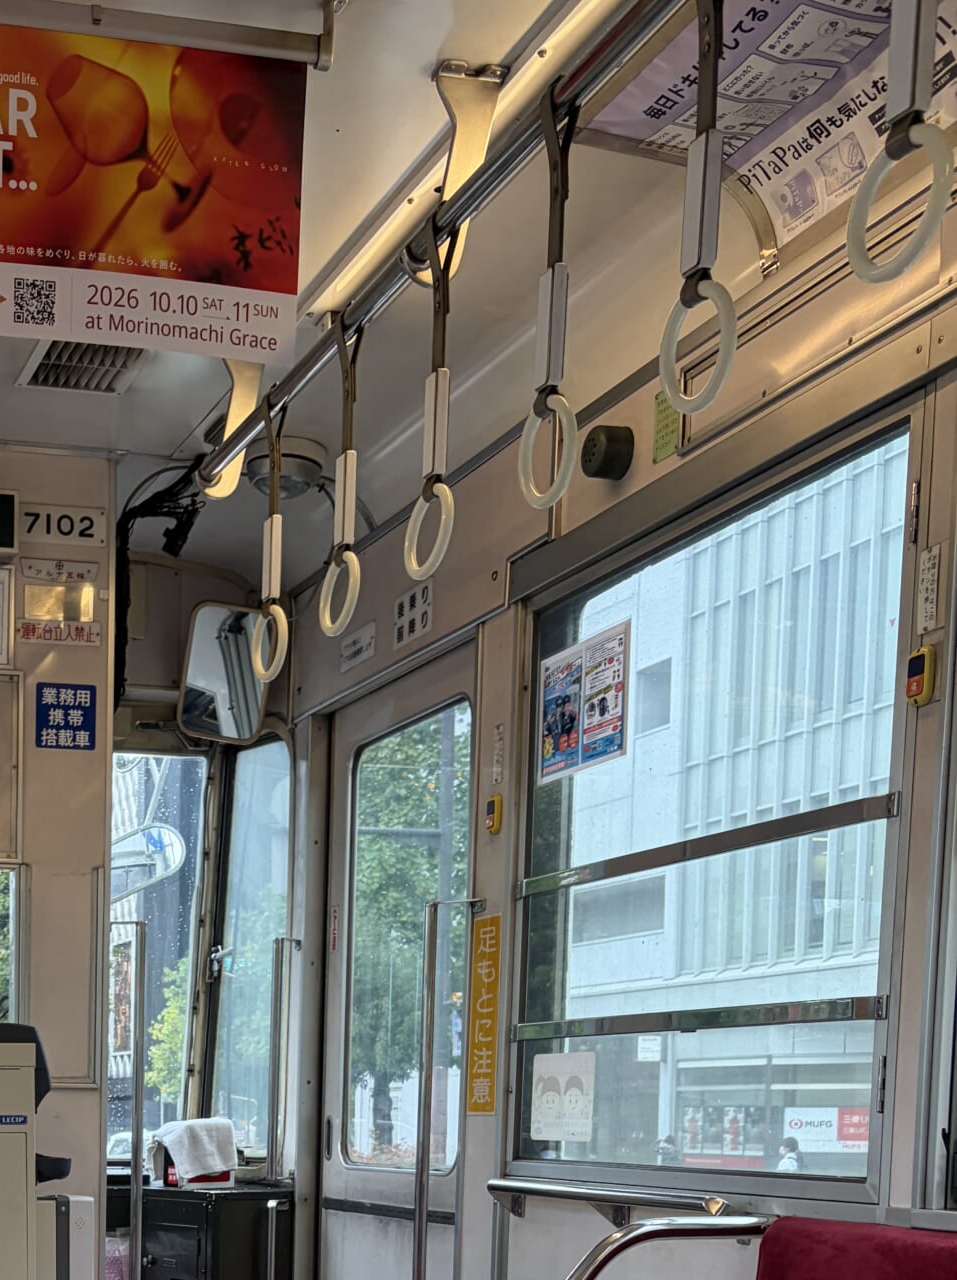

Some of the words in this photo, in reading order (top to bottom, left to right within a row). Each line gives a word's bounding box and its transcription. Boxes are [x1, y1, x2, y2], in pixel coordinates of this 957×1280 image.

[86, 284, 139, 309] 2026
[149, 291, 198, 316] 10.10
[202, 297, 225, 311] SAT
[253, 304, 279, 319] SUN
[85, 314, 103, 330] at
[109, 314, 224, 344] Morinomachi
[230, 328, 277, 351] Grace
[24, 512, 94, 538] 7102
[21, 622, 96, 643] 運転台立入禁止
[42, 687, 90, 707] 業務用
[48, 708, 83, 726] 携帯
[41, 728, 90, 747] 搭載車
[471, 926, 497, 1103] 足もとに注意
[805, 1120, 833, 1128] MUFG
